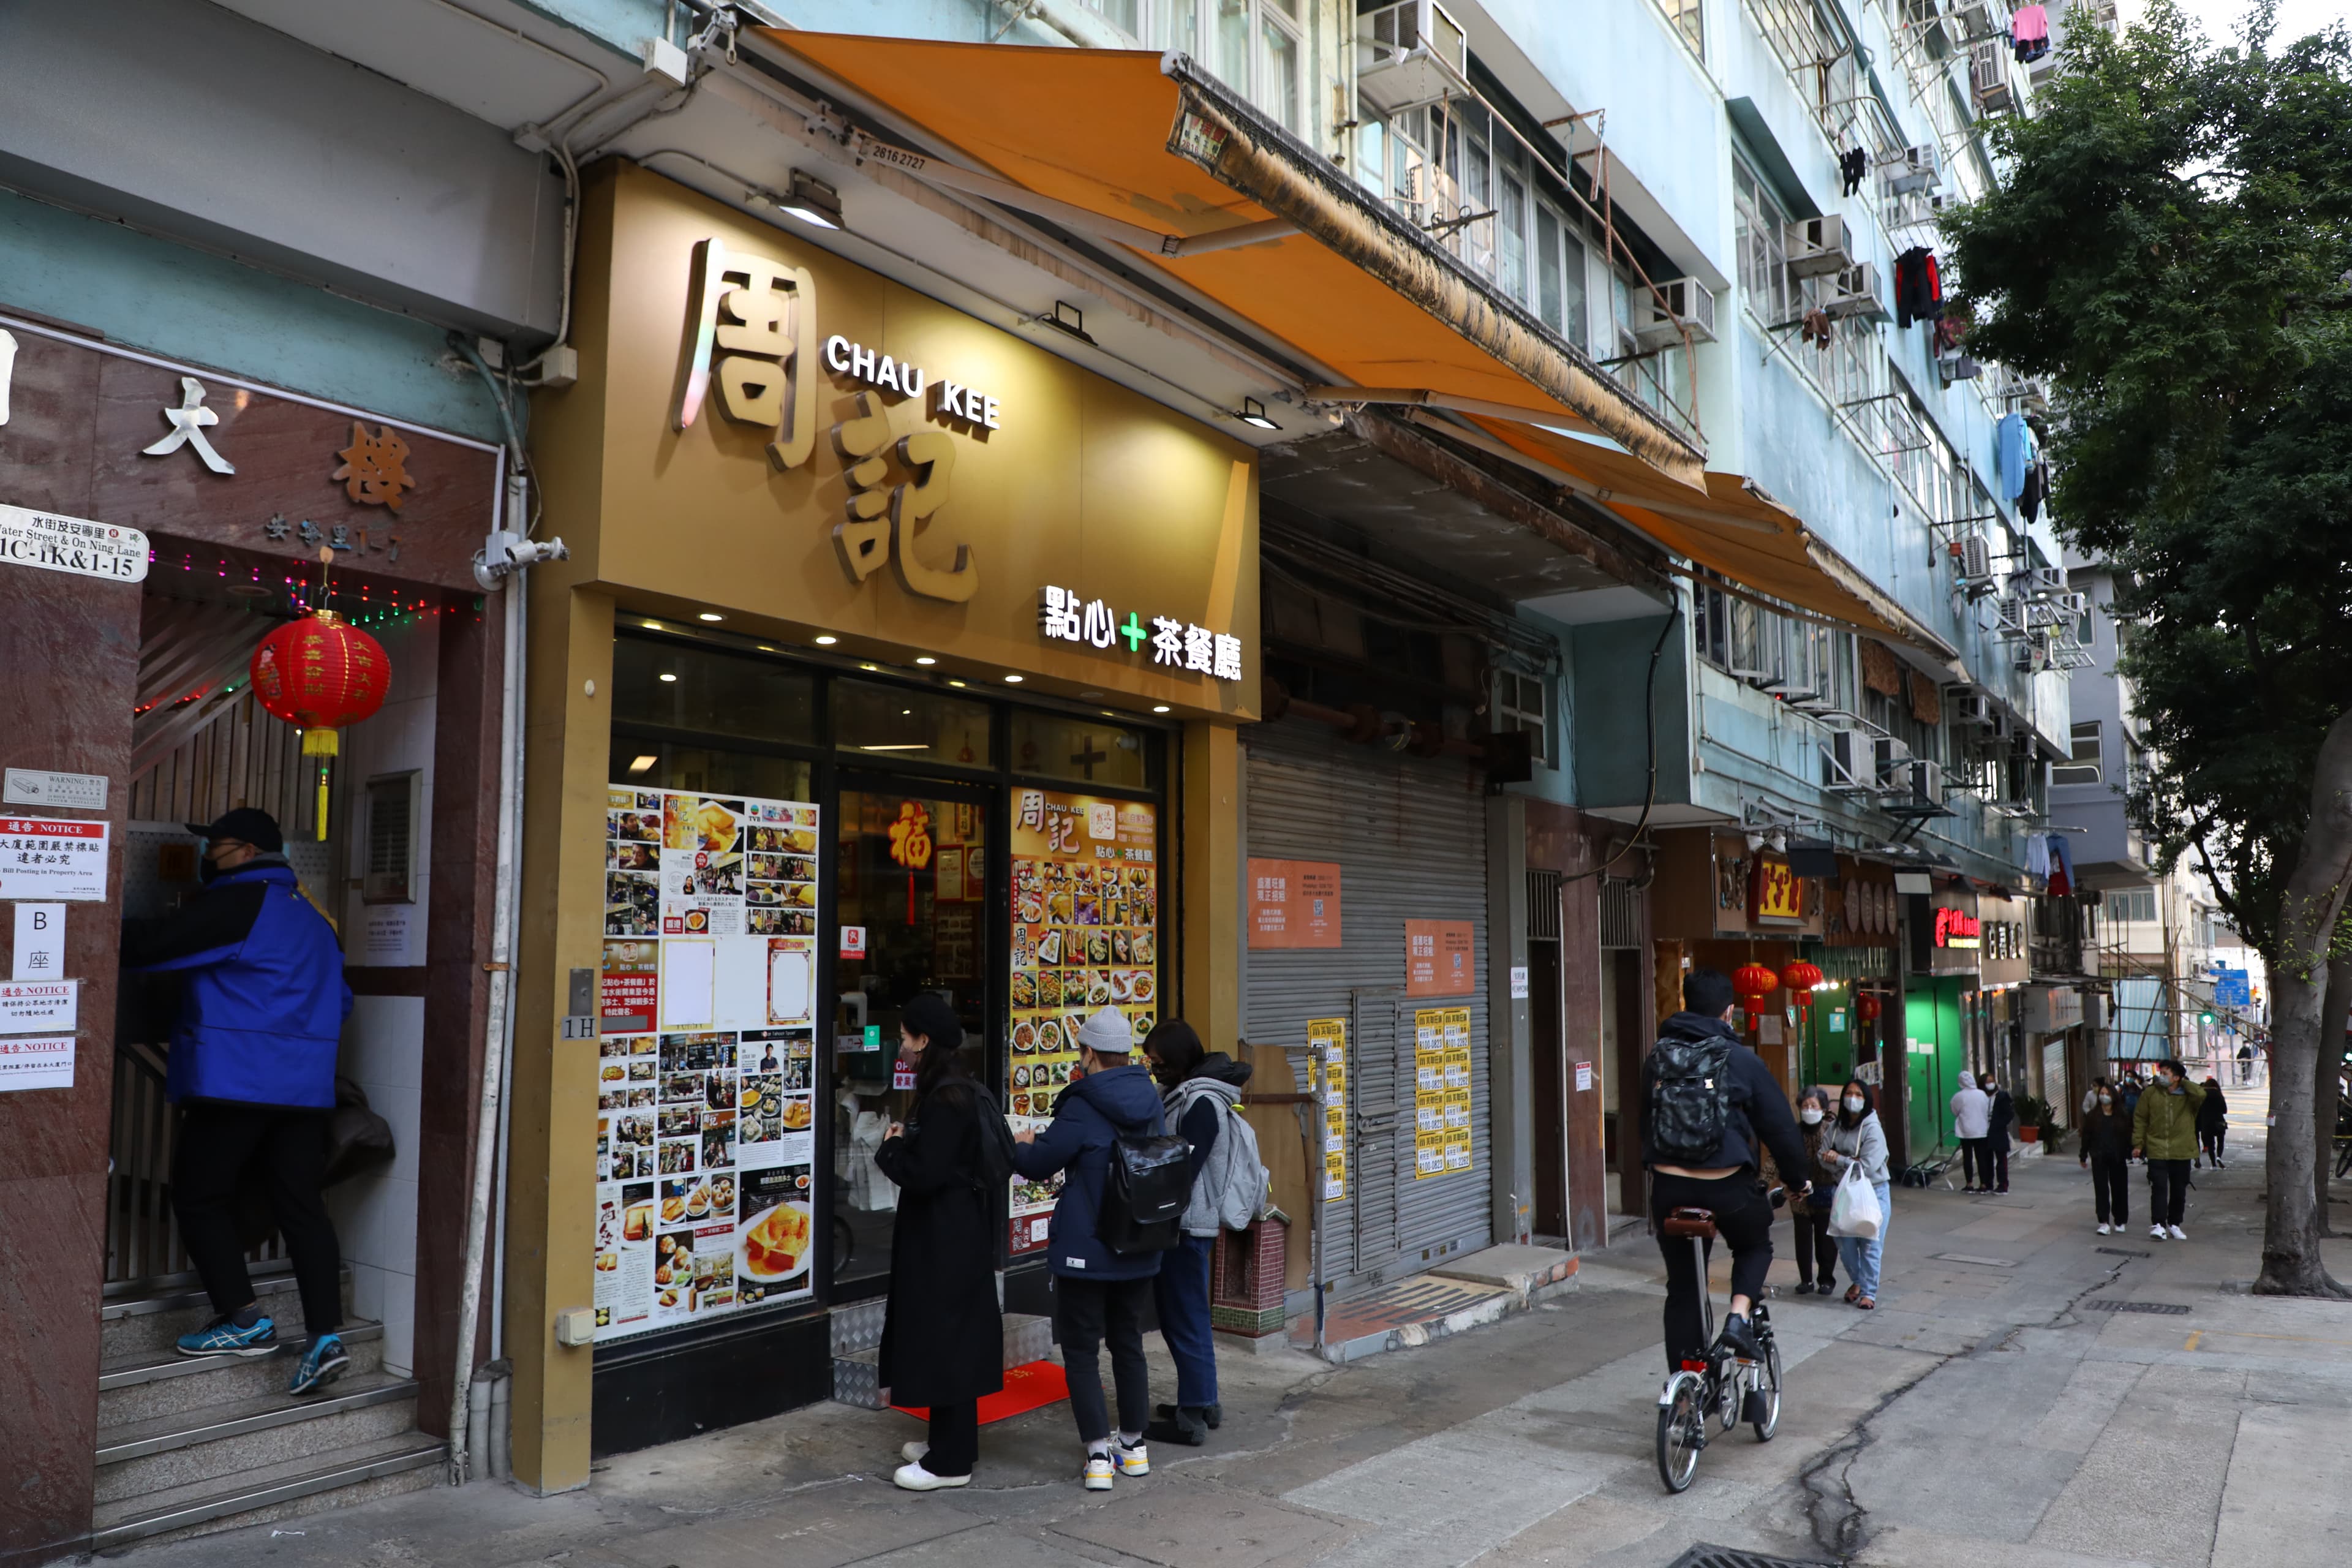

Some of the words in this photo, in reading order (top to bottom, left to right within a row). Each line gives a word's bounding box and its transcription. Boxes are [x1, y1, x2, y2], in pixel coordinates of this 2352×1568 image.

[873, 145, 899, 162] 2816
[900, 152, 925, 170] 2727
[827, 334, 924, 398] CHAU
[943, 380, 1000, 430] KEE
[32, 516, 105, 539] 水街及安寧里
[0, 524, 23, 537] ater
[26, 529, 58, 543] Street
[61, 535, 69, 545] &
[72, 537, 86, 548] On
[89, 540, 114, 556] Ning
[118, 545, 141, 558] Lane
[1046, 585, 1242, 680] 點心+茶餐廳
[49, 775, 88, 785] WARNING:
[1046, 803, 1067, 813] CHAU
[1071, 805, 1084, 815] KEE
[8, 821, 34, 832] 通告
[40, 824, 83, 834] NOTICE
[1016, 791, 1080, 854] 周記
[888, 801, 932, 870] 福
[17, 852, 70, 865] 違者必究
[33, 912, 47, 930] B
[1014, 927, 1027, 966] 周記
[28, 951, 50, 969] 座
[2, 987, 23, 997] 通告
[27, 986, 69, 995] NOTICE
[0, 1043, 21, 1054] 通告
[25, 1042, 67, 1051] NOTICE
[0, 1061, 72, 1071] 禁阻塞/停留在本大廈門口
